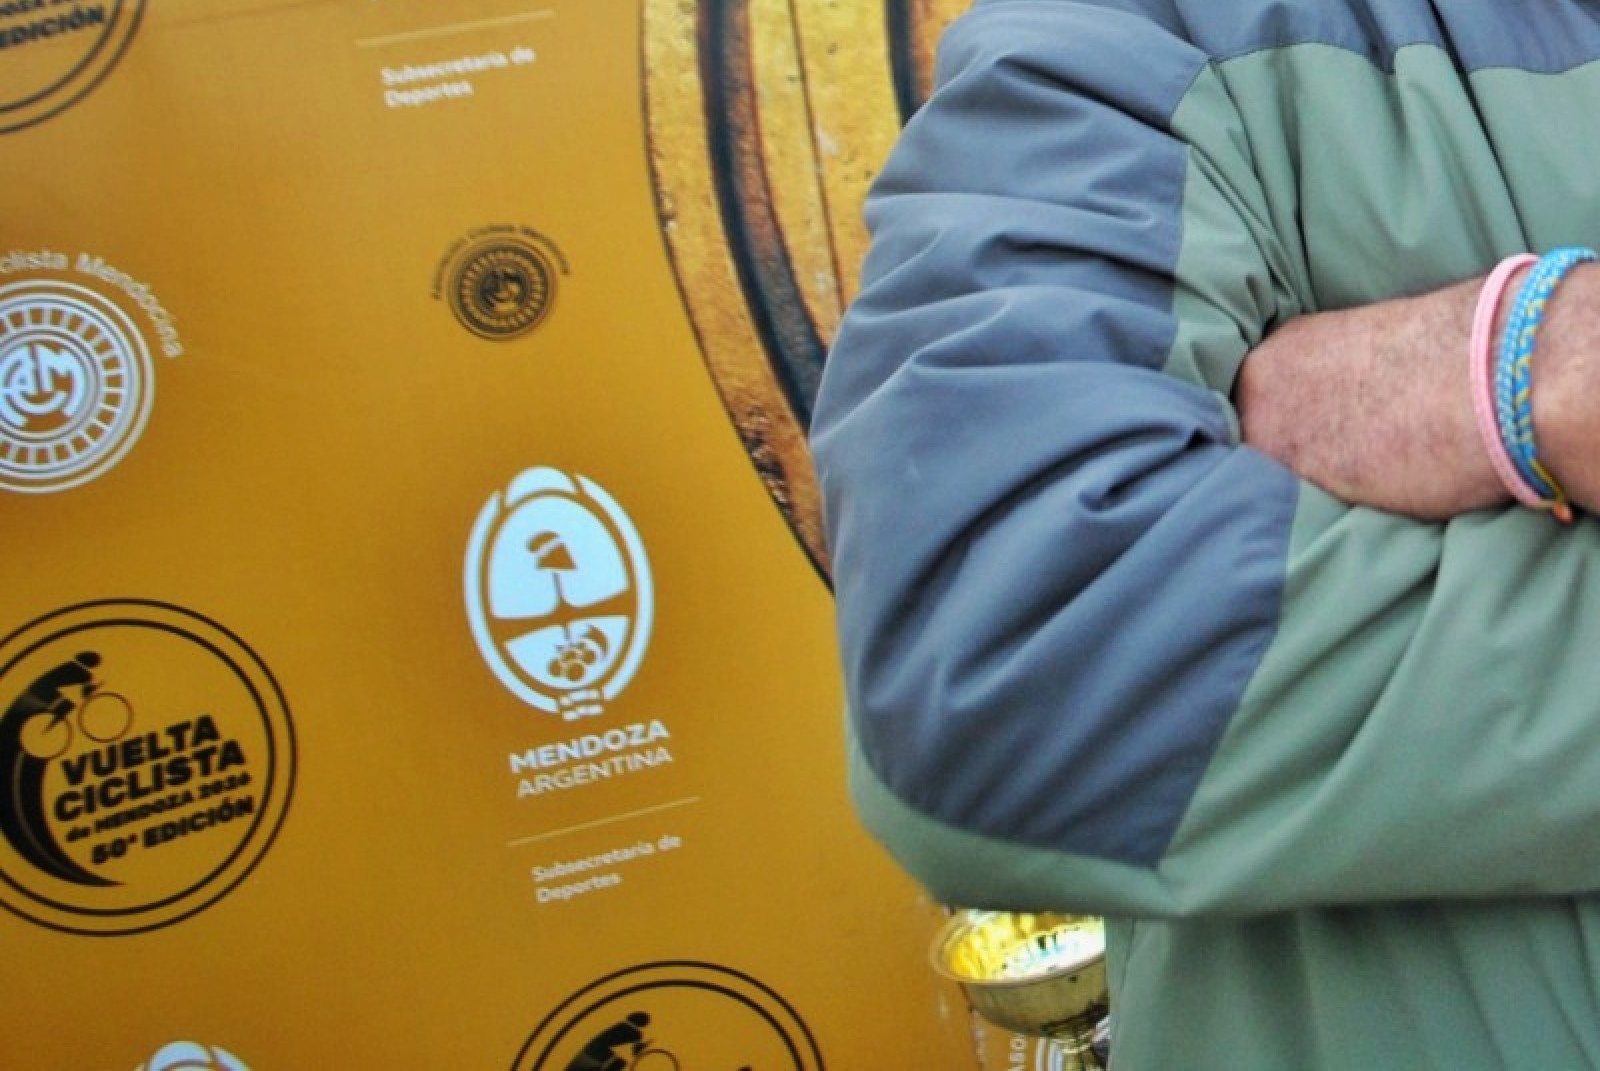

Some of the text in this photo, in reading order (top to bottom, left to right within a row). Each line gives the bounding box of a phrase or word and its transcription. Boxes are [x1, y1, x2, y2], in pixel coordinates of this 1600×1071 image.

[509, 45, 537, 65] de
[384, 80, 475, 108] Deportes
[61, 715, 219, 786] VUELTA
[509, 719, 671, 774] MENDOZA
[54, 741, 245, 822] CICLISTA
[517, 747, 674, 799] ARGENTINA
[95, 790, 194, 833] MENDOZA
[141, 796, 254, 849] EDICIÓN
[657, 834, 683, 852] de
[536, 873, 622, 904] Deportes
